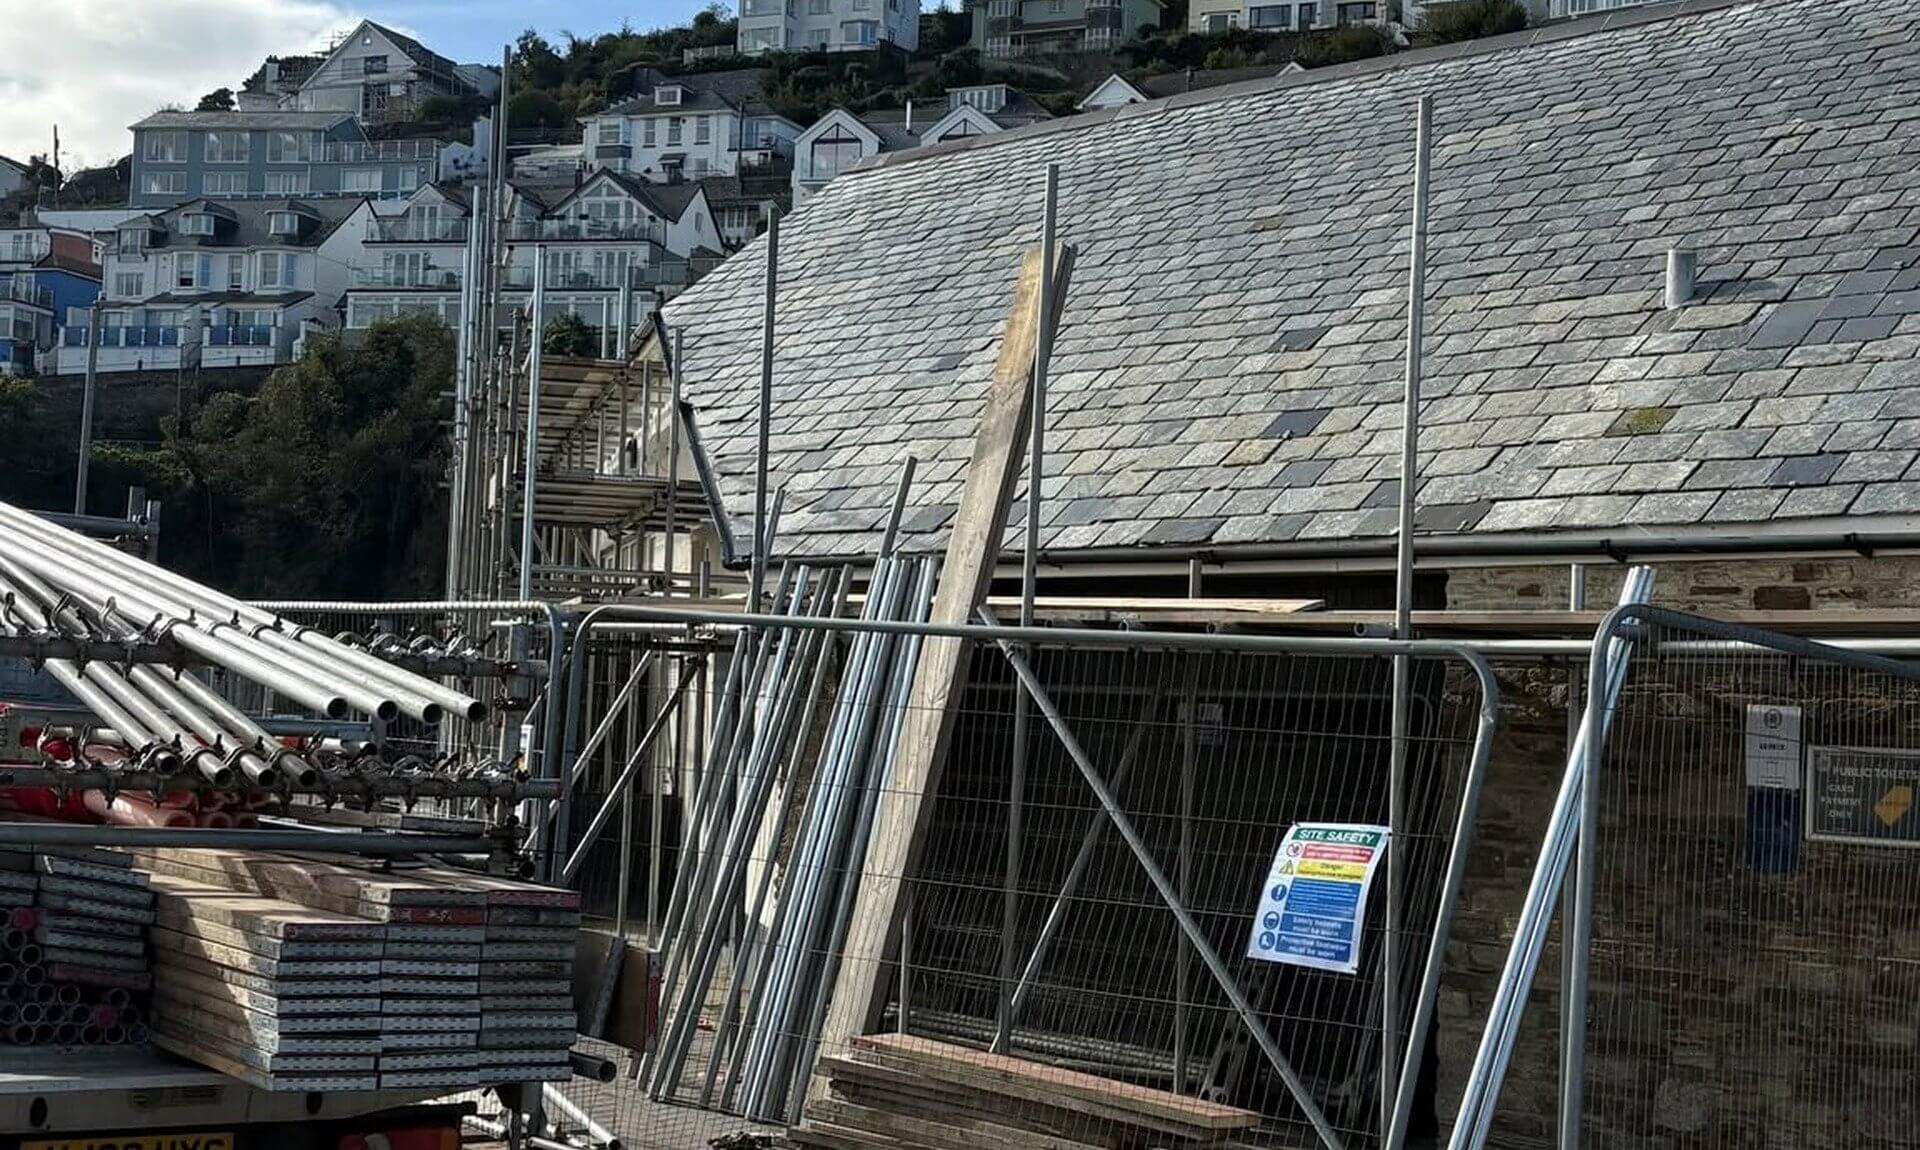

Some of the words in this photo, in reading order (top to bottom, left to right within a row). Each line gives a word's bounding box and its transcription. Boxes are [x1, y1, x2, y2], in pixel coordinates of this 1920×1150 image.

[1833, 767, 1872, 777] PUBLIC
[1875, 768, 1919, 779] TOILETS
[1299, 830, 1325, 841] SITE
[1326, 831, 1375, 844] SAFETY
[1293, 916, 1313, 926] Safety
[1314, 919, 1342, 929] helmets
